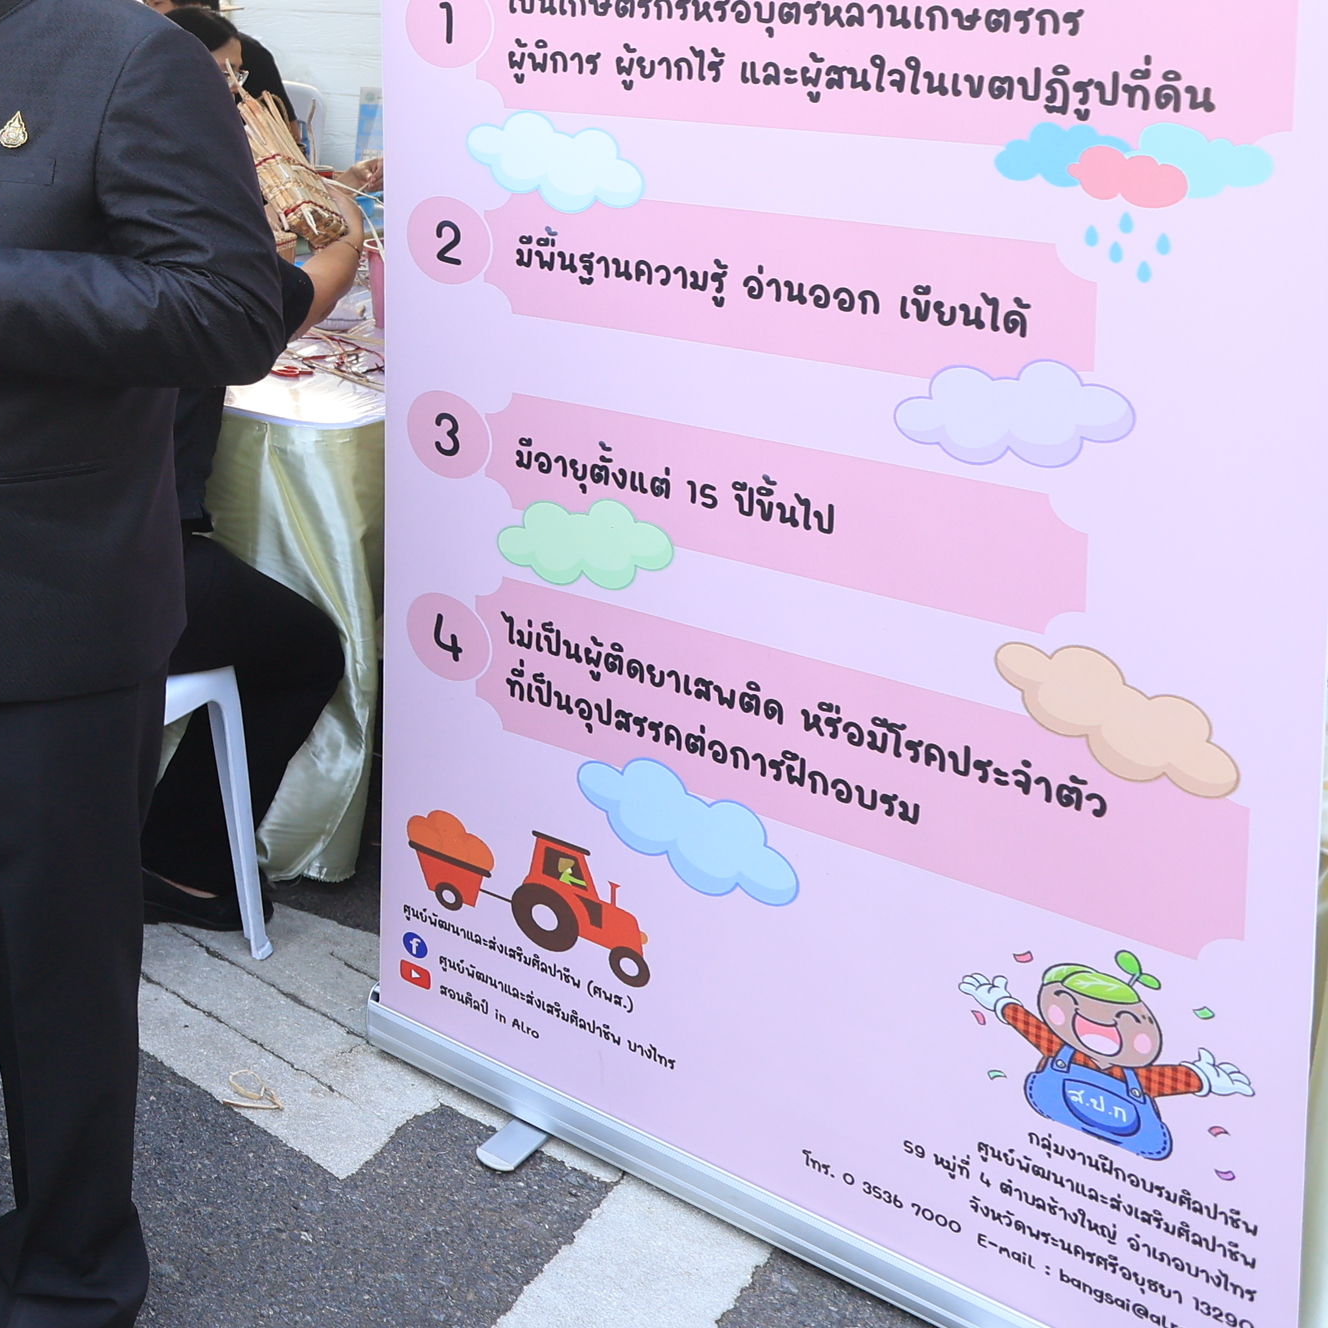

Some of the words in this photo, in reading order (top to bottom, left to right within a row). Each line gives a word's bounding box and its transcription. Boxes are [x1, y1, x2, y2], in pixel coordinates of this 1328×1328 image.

[439, 1, 453, 45] 1
[507, 37, 602, 85] ผู้พิการ
[615, 42, 726, 91] ผู้ยากไร้
[740, 51, 1215, 122] และผู้สนใจในเขตปฏิรูปที่ดิน
[435, 220, 462, 266] 2
[515, 225, 729, 308] มีพื้นฐานความรู้
[742, 264, 880, 315] อ่านออก
[899, 284, 1032, 338] เขียนได้
[434, 412, 460, 457] 3
[515, 437, 671, 500] มีอายุตั้งแต่
[686, 480, 718, 510] 15
[731, 474, 835, 535] ปีขึ้นไป
[433, 612, 464, 663] 4
[500, 610, 784, 726] ไม่เป็นผู้ติดยาเสพติด
[800, 701, 1108, 818] หรือมีโรคประจำตัว
[505, 667, 920, 825] ที่เป็นอุปสรรคต่อการฝึกอบรม
[403, 904, 581, 989] ศูนย์พัฒนาและส่งเสริมศิลปาชีพ
[586, 979, 634, 1014] (ศพส.)
[438, 955, 621, 1046] ศูนย์พัฒนาและส่งเสริมศิลปาชีพ
[627, 1039, 676, 1070] บางไทร
[439, 984, 489, 1015] สอนศิลป์
[495, 1012, 507, 1024] in
[511, 1018, 540, 1039] Alro
[1066, 1088, 1128, 1124] ส.ป.ก
[801, 1149, 835, 1178] โทร.
[842, 1172, 855, 1186] 0
[862, 1181, 904, 1209] 3536
[911, 1202, 962, 1233] 7000
[977, 1233, 1035, 1269] E-mail
[903, 1139, 926, 1159] 59
[933, 1153, 970, 1180] หมู่ที่
[979, 1171, 992, 1188] 4
[999, 1178, 1117, 1245] ตำบลช้างใหญ่
[1126, 1233, 1257, 1303] อำเภอบางไทร
[977, 1141, 1256, 1270] ศูนย์พัฒนาและส่งเสริมศิลปาชีพ
[1027, 1132, 1258, 1237] กลุ่มงานฝึกอบรมศิลปาชีพ
[969, 1195, 1183, 1305] จังหวัดพระนครศรีอยุธยา
